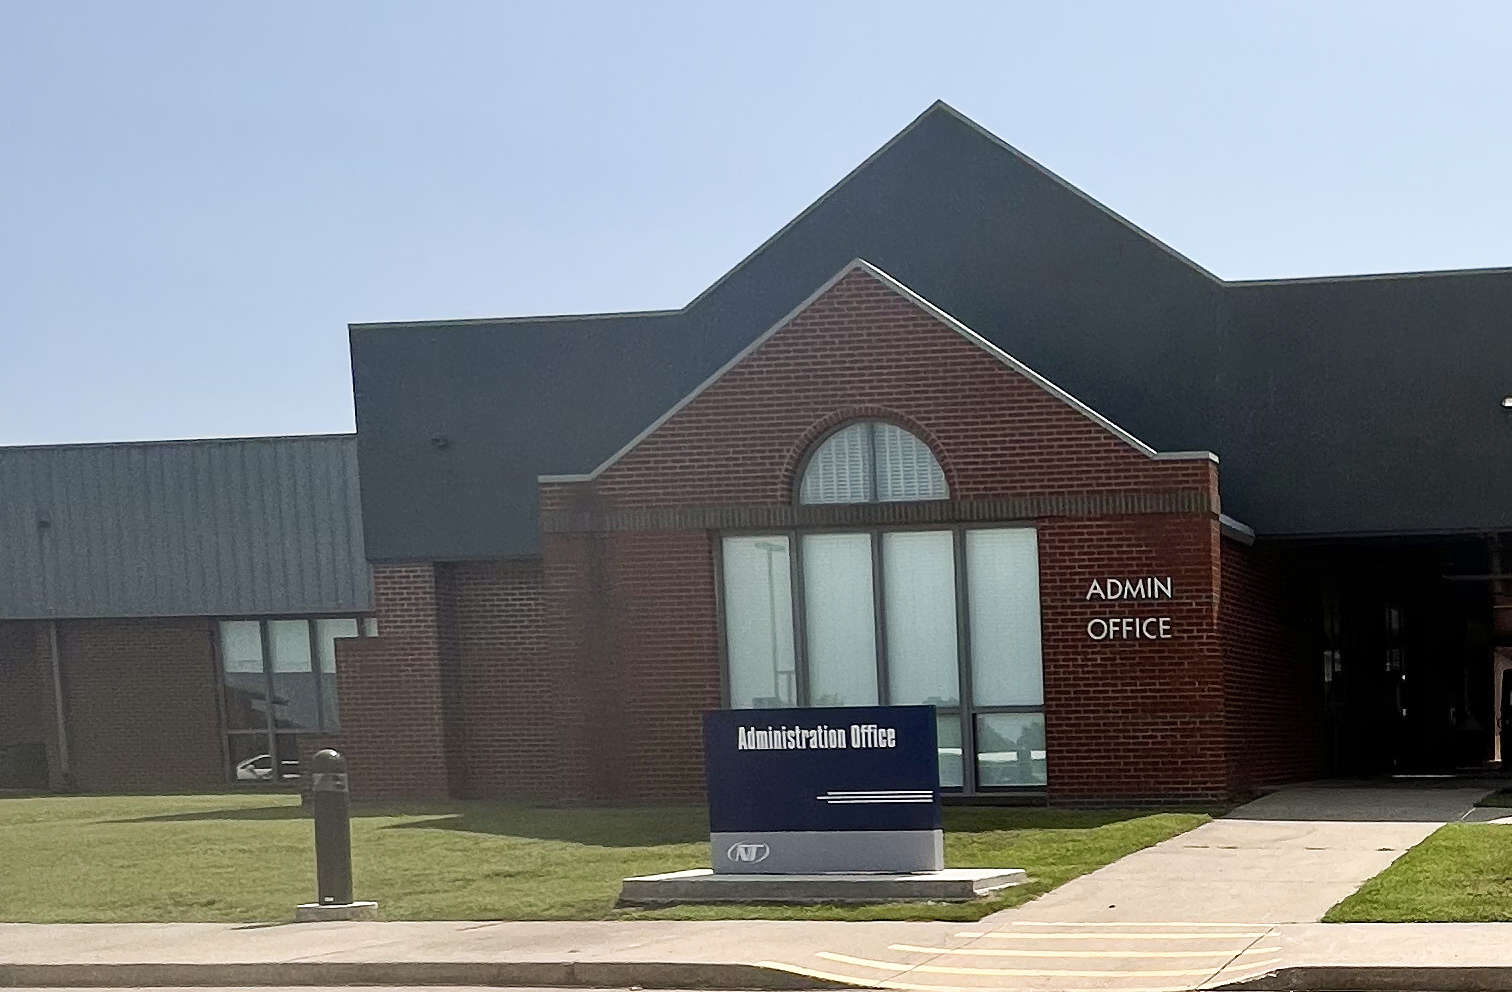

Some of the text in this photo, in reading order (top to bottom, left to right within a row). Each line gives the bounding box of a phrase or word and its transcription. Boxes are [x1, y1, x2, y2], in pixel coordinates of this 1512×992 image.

[1085, 576, 1172, 601] ADMIN
[1087, 617, 1172, 640] OFFICE
[738, 724, 896, 750] Administration Office
